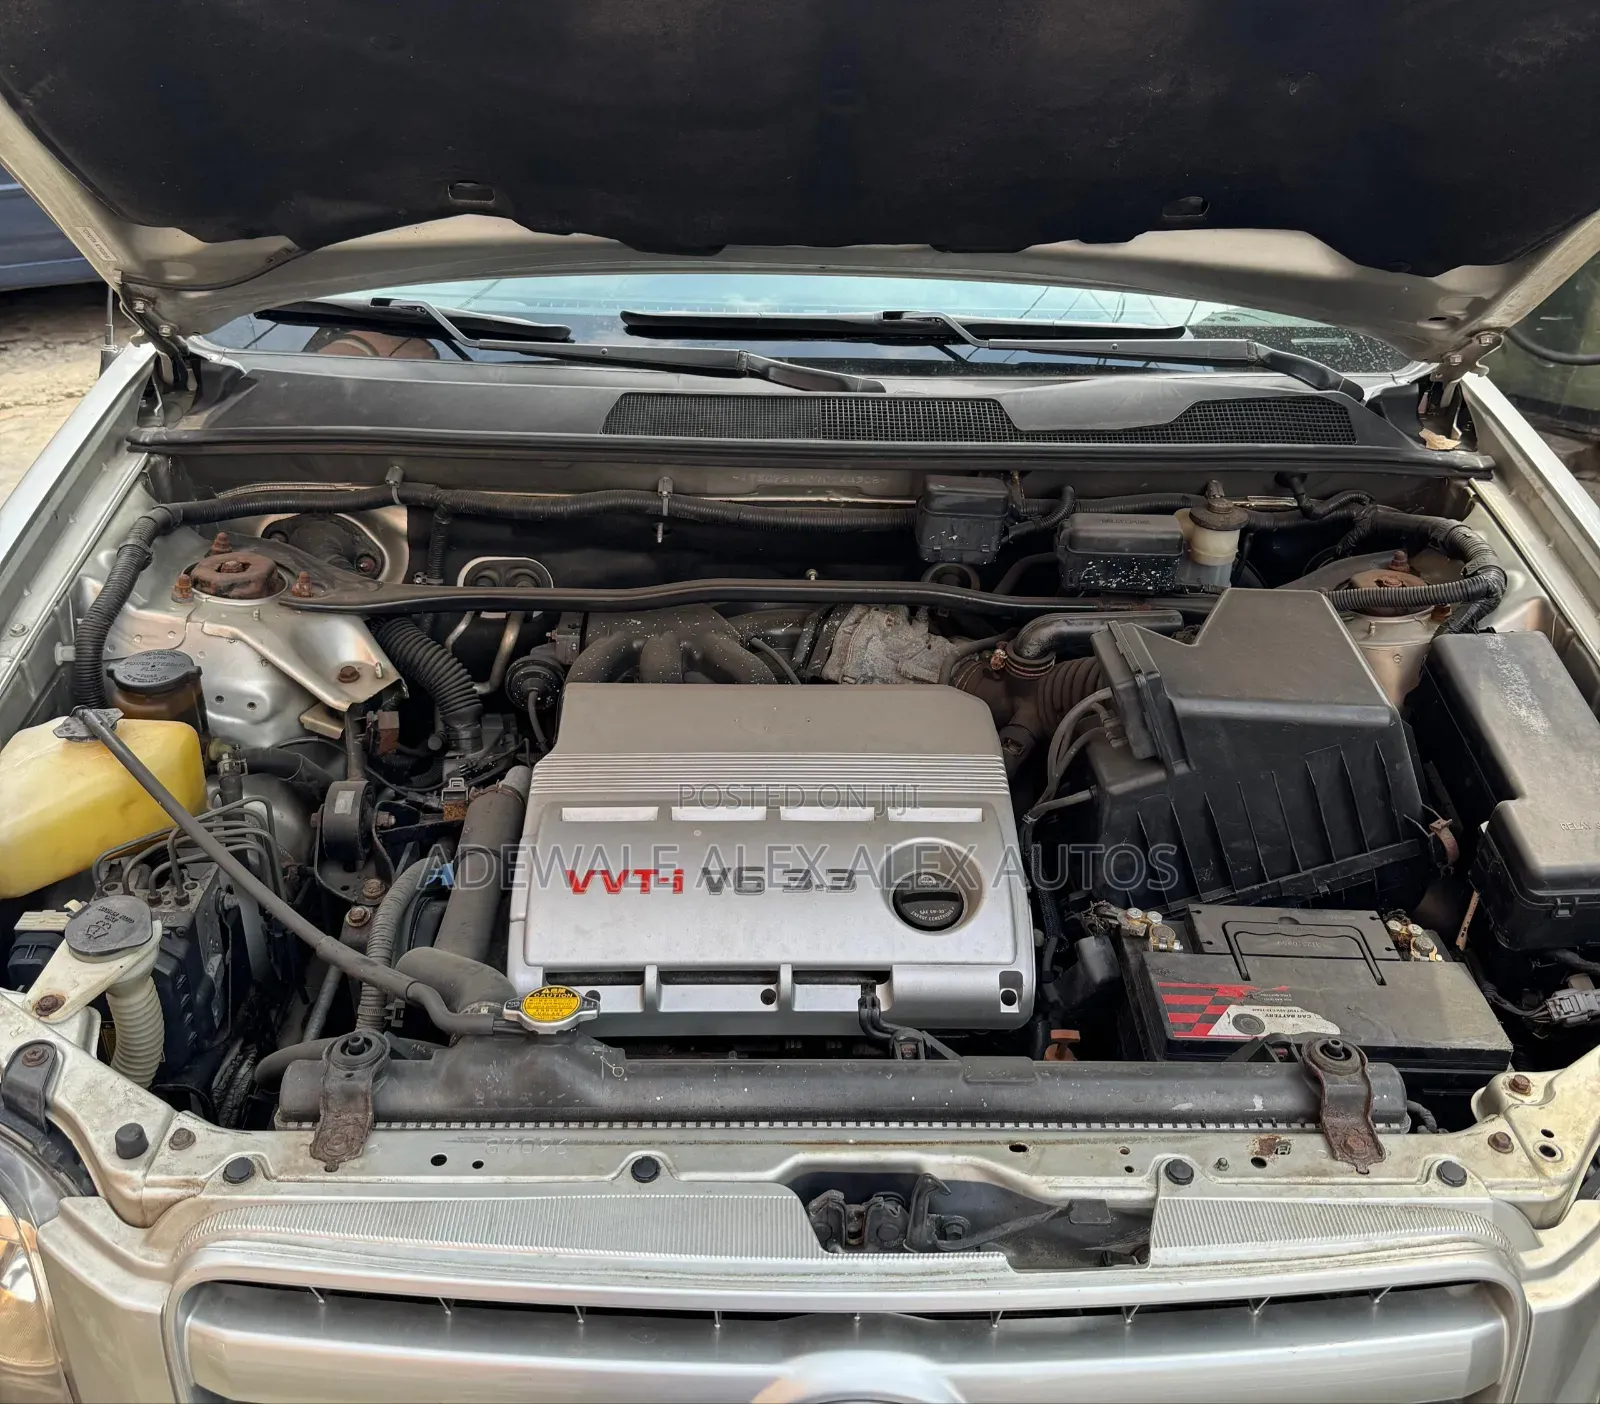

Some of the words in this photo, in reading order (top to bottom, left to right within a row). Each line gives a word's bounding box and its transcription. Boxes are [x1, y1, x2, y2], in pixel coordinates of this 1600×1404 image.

[1560, 822, 1591, 831] RELAY
[565, 868, 685, 895] VVT-i
[701, 866, 766, 896] V6
[782, 868, 858, 894] 3.3
